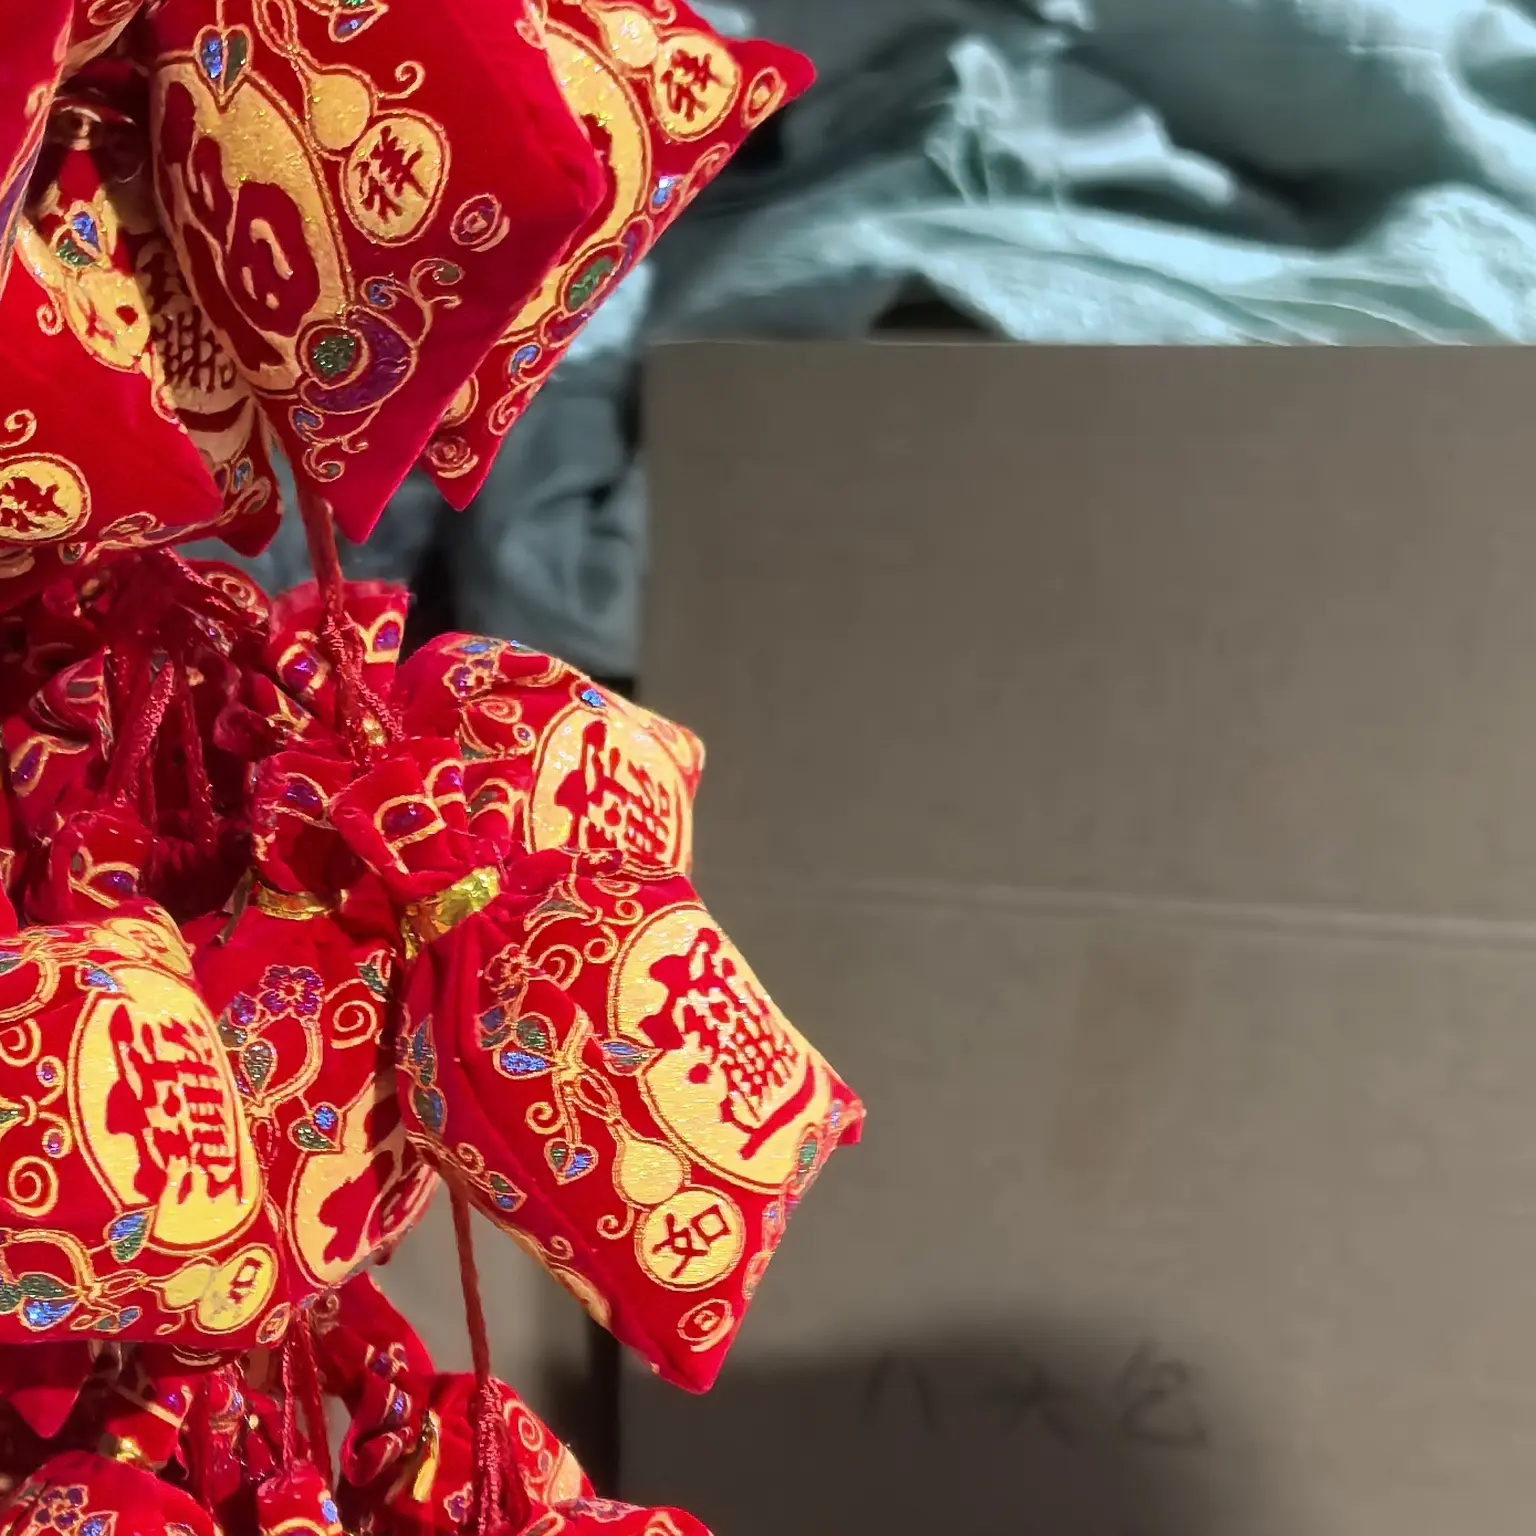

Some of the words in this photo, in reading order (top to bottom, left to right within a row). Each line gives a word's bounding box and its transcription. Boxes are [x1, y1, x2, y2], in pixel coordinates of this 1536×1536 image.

[663, 47, 727, 124] 祥
[355, 125, 425, 224] 祥
[652, 1204, 731, 1277] 如
